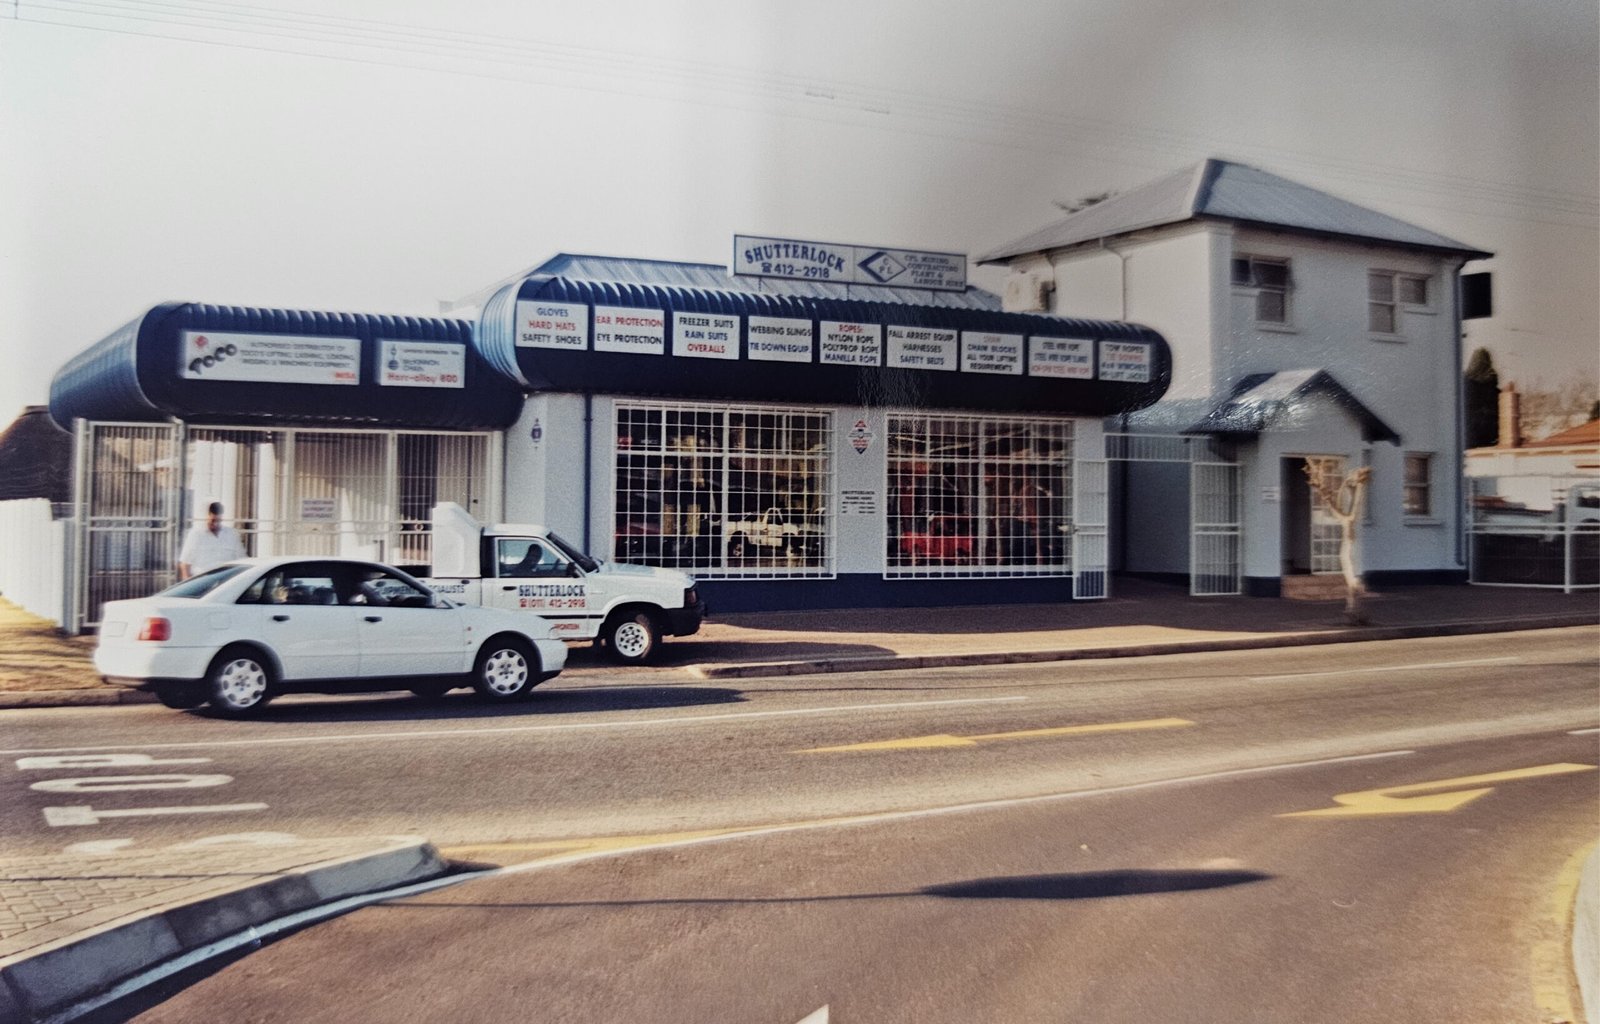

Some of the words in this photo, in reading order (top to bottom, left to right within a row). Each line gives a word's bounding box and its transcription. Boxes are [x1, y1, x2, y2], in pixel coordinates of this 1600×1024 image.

[745, 244, 845, 272] SHUTTERLOCK
[774, 263, 829, 278] 412-2918
[536, 307, 568, 317] GLOVES
[528, 320, 552, 329] HARD
[555, 322, 576, 331] HATS
[596, 316, 612, 324] EAR
[615, 316, 663, 327] PROTECTION
[679, 316, 710, 327] FREEZER
[714, 319, 734, 329] SUITS
[685, 330, 704, 339] RAIN
[708, 331, 728, 341] SUITS
[750, 325, 785, 336] WEBBING
[786, 327, 812, 337] SLINGS
[888, 330, 904, 338] FALL
[906, 331, 931, 341] ARREST
[522, 333, 551, 343] SAFETY
[555, 335, 582, 345] SHOES
[596, 333, 611, 342] EYE
[614, 334, 662, 345] PROTECTION
[827, 333, 853, 343] NYLON
[856, 335, 874, 344] ROPE
[687, 343, 725, 354] OVERALLS
[750, 342, 759, 351] TIE
[761, 343, 786, 352] DOWN
[822, 343, 858, 352] POLYPROP
[861, 345, 879, 354] ROPE
[902, 343, 943, 353] HARNESSES
[991, 345, 1017, 353] BLOCKS
[824, 353, 856, 362] MANILLA
[859, 354, 877, 364] ROPE
[900, 354, 924, 364] SAFETY
[926, 356, 945, 366] BELTS
[519, 585, 586, 597] SHUTTERLOCK
